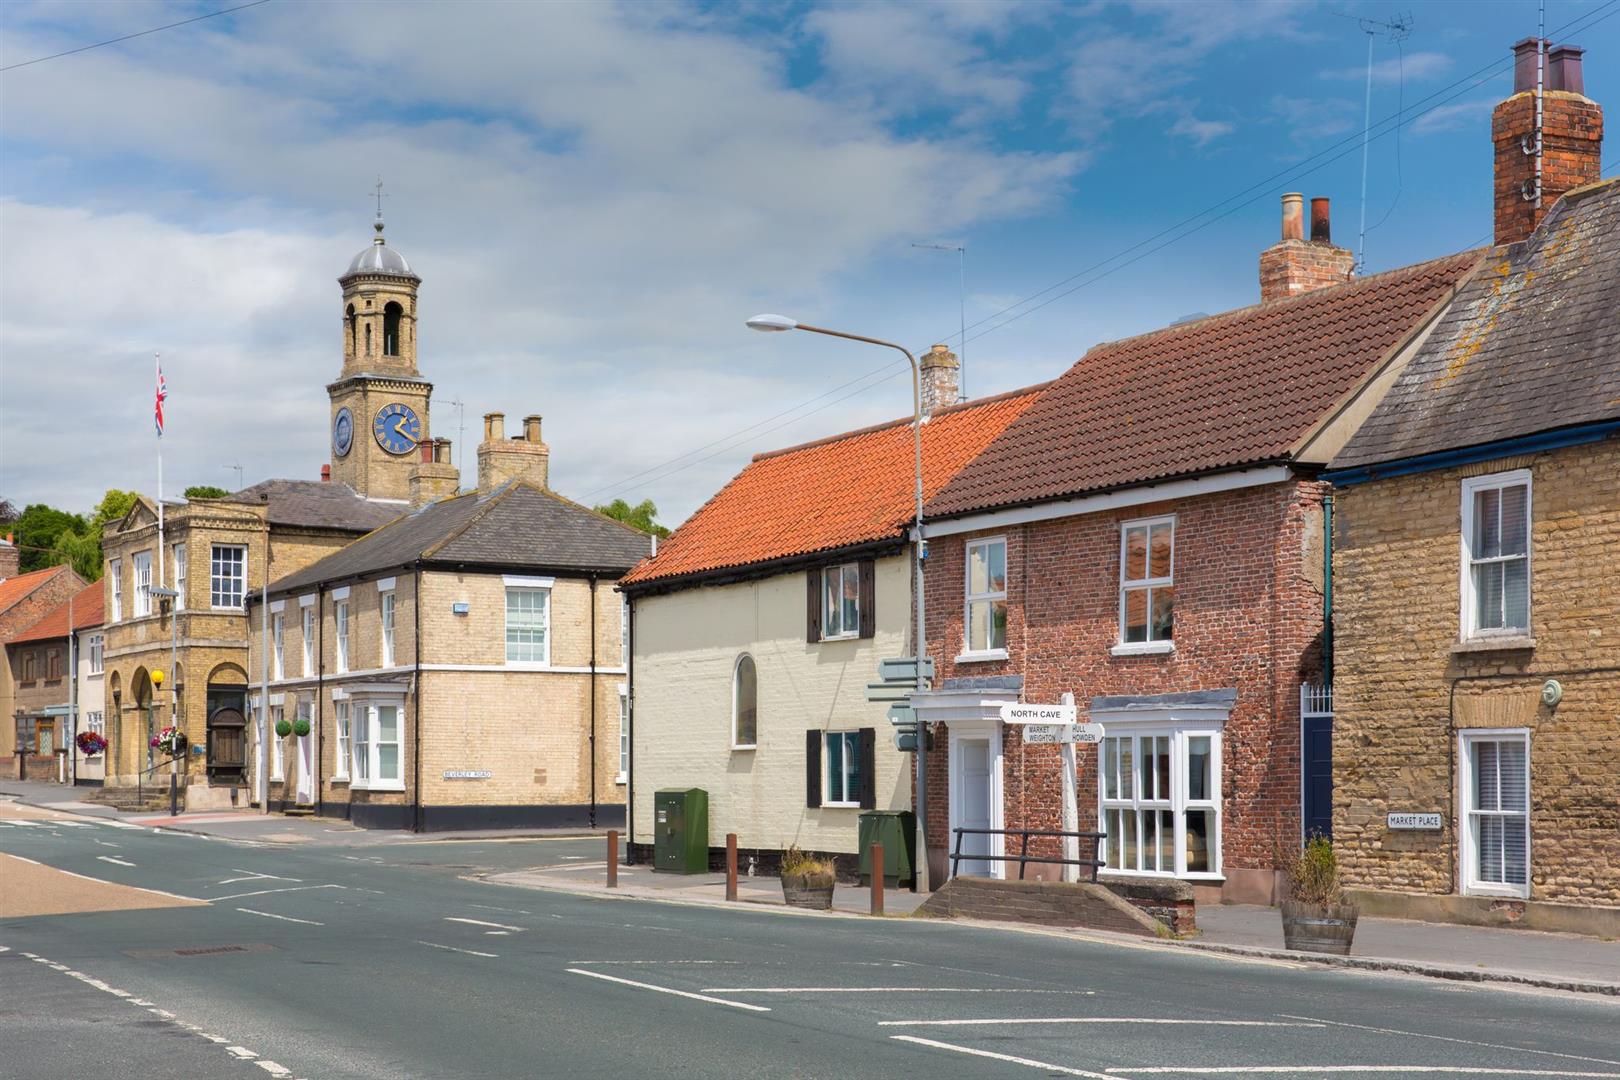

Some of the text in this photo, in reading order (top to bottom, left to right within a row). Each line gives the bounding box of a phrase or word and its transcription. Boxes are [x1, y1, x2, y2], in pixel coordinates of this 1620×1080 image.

[1010, 710, 1060, 719] NORTH CAVE
[1390, 816, 1438, 826] MARKET PLACE
